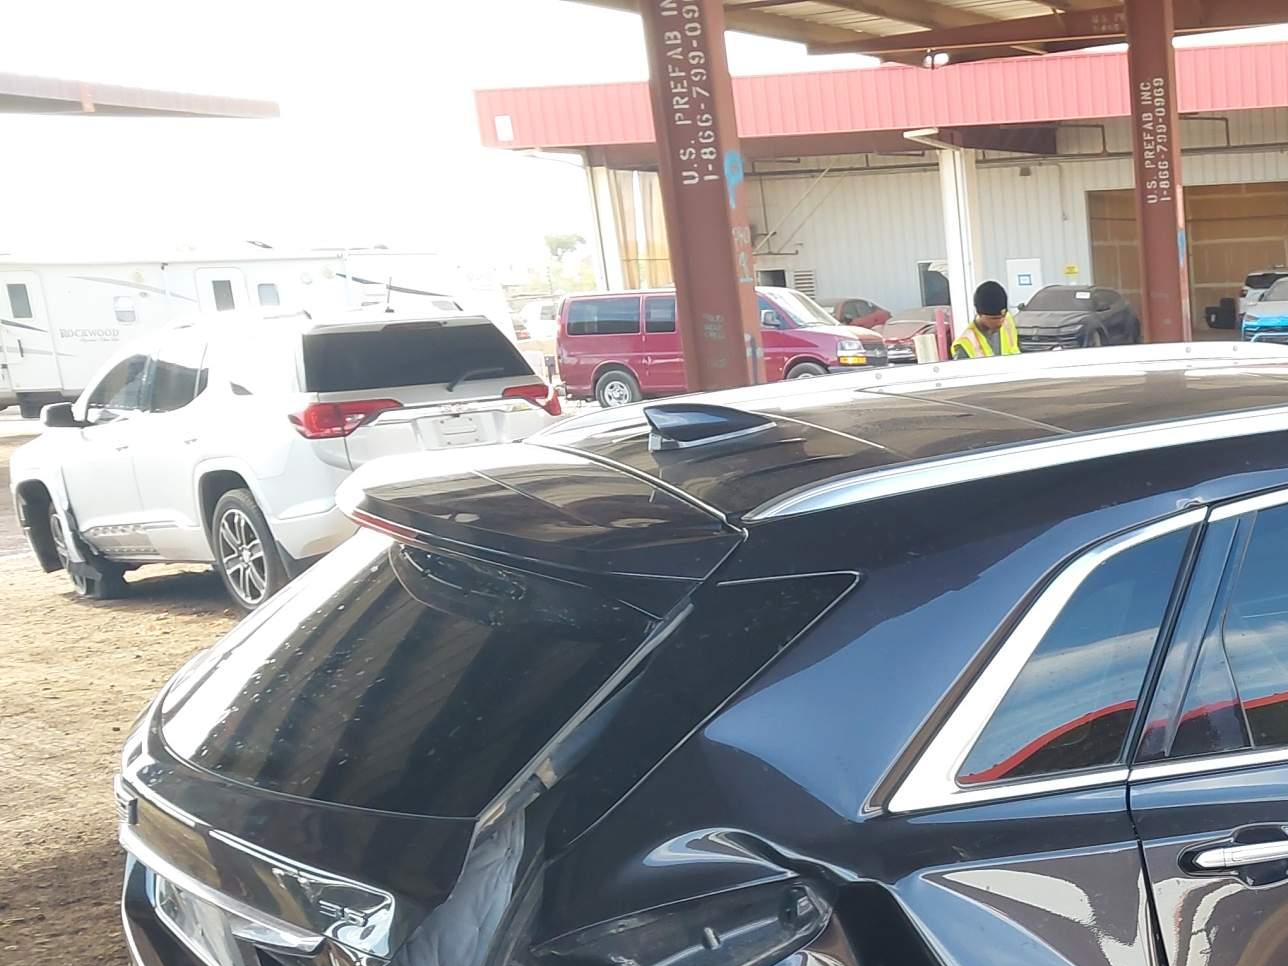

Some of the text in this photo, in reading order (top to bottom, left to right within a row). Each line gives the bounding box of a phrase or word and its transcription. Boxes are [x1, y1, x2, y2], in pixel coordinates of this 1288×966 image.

[664, 31, 692, 125] PREFAB
[682, 0, 720, 181] 1-866-799-09
[680, 139, 700, 185] U.S.
[1142, 112, 1156, 168] PREFAB
[1152, 77, 1172, 201] 1-866-799-0969
